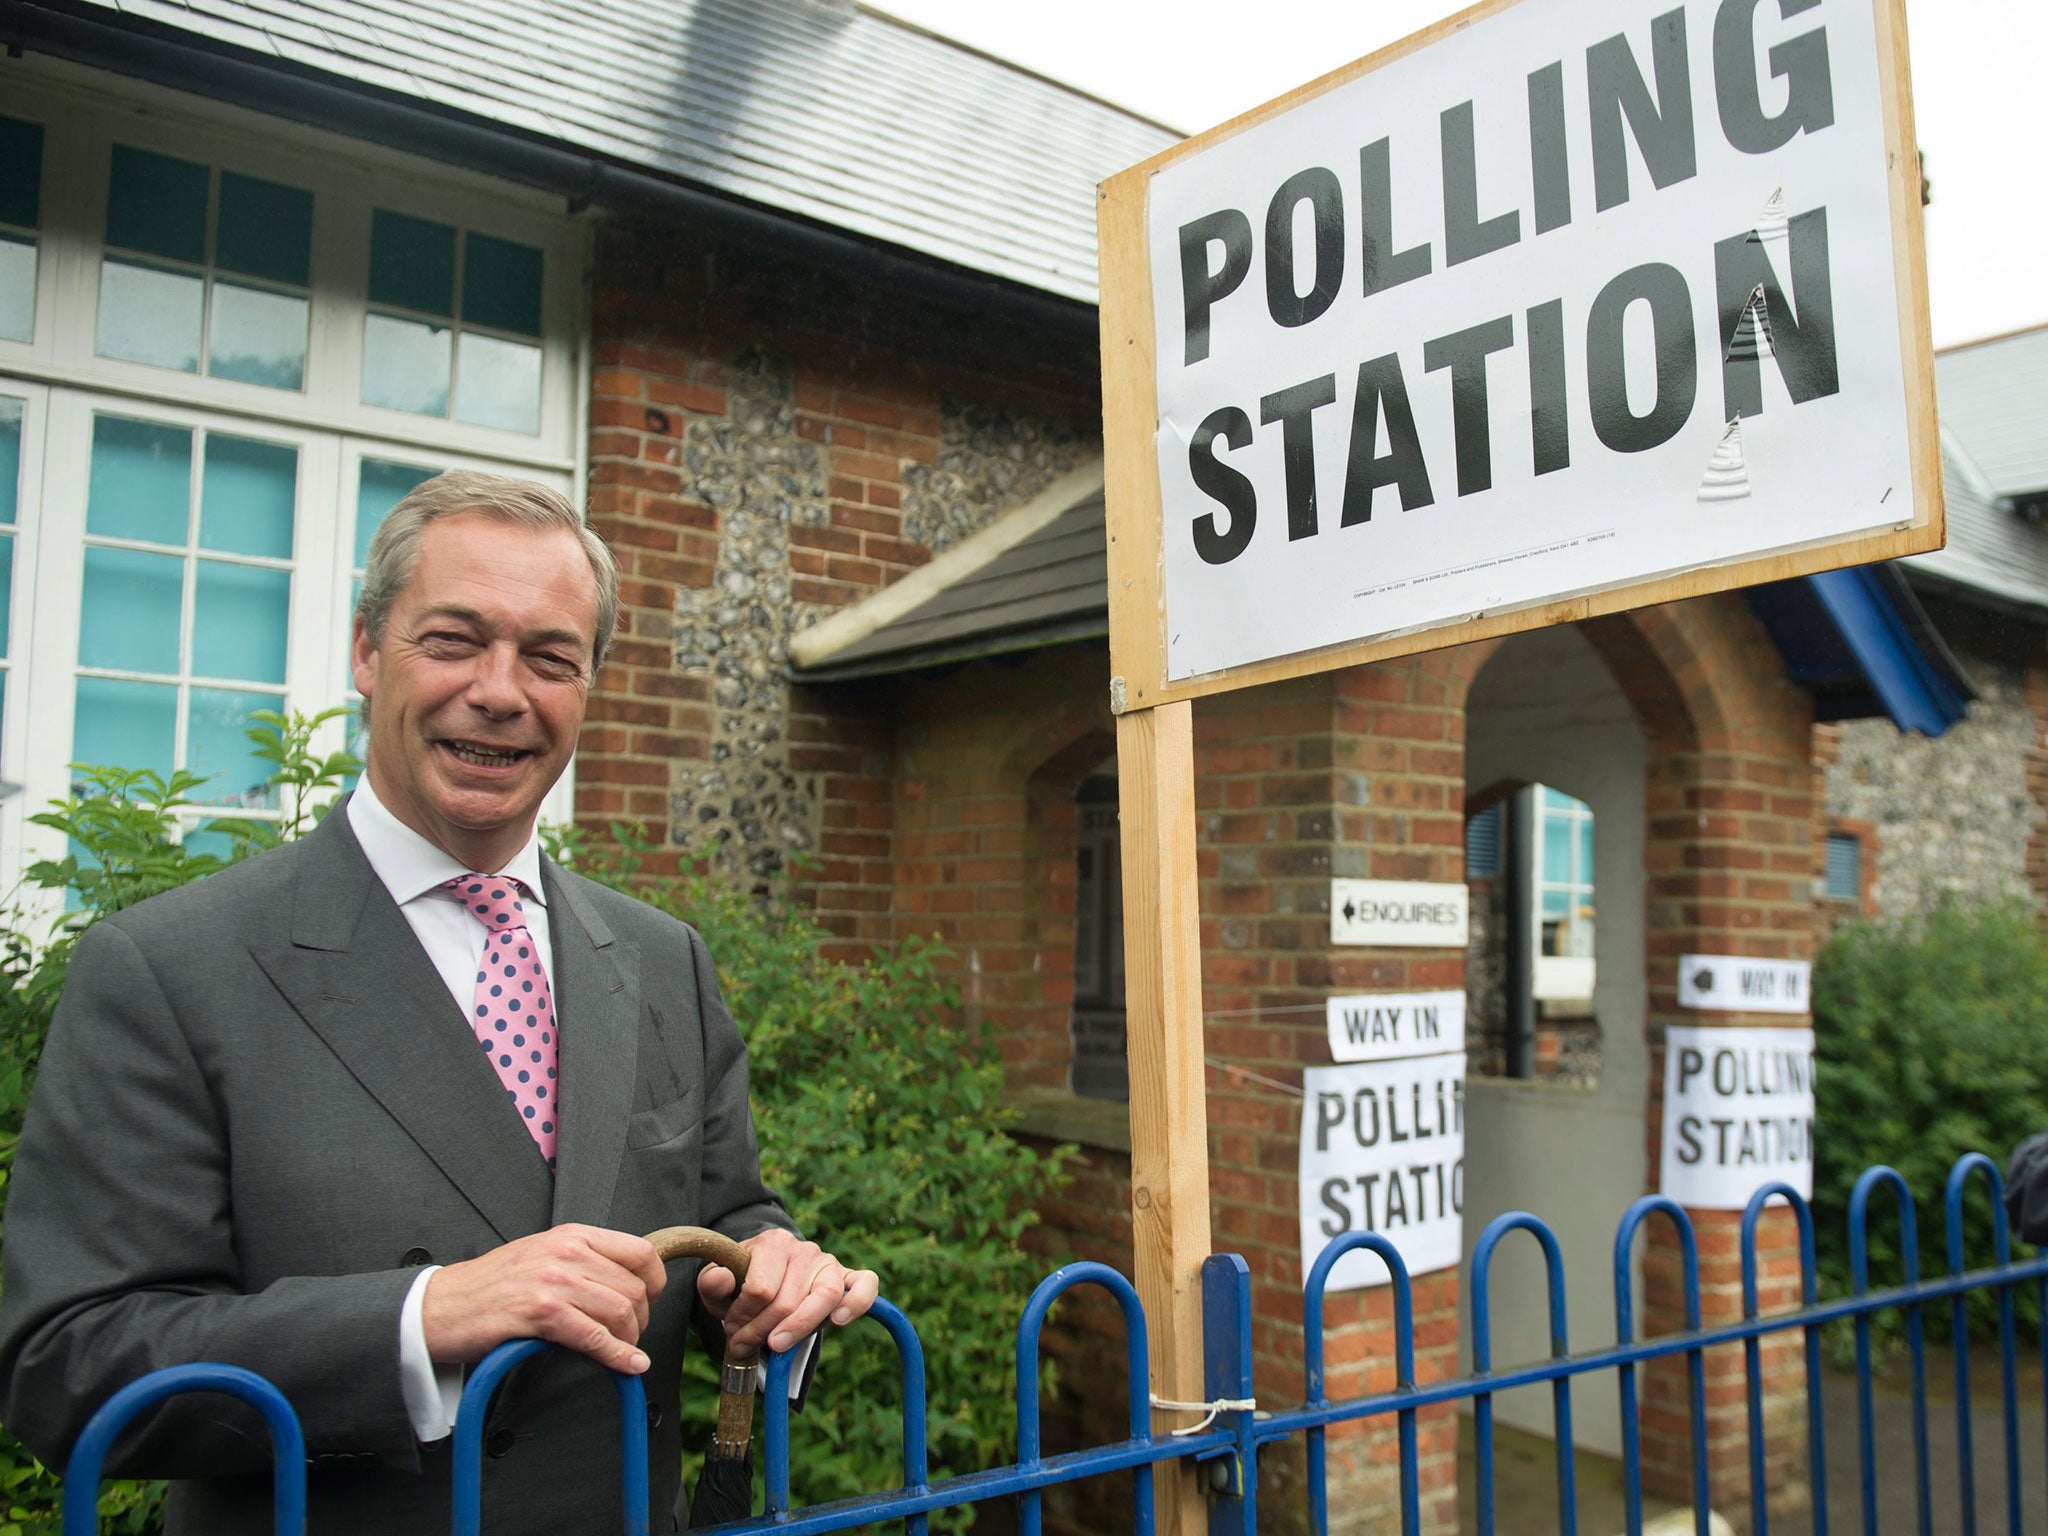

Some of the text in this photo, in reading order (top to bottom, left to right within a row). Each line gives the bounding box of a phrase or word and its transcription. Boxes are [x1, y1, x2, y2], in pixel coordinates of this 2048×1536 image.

[1179, 0, 1835, 367] POLLING
[1189, 206, 1839, 565] STATION
[1360, 900, 1459, 925] ENQUIRIES
[1344, 1006, 1439, 1044] WAY IN
